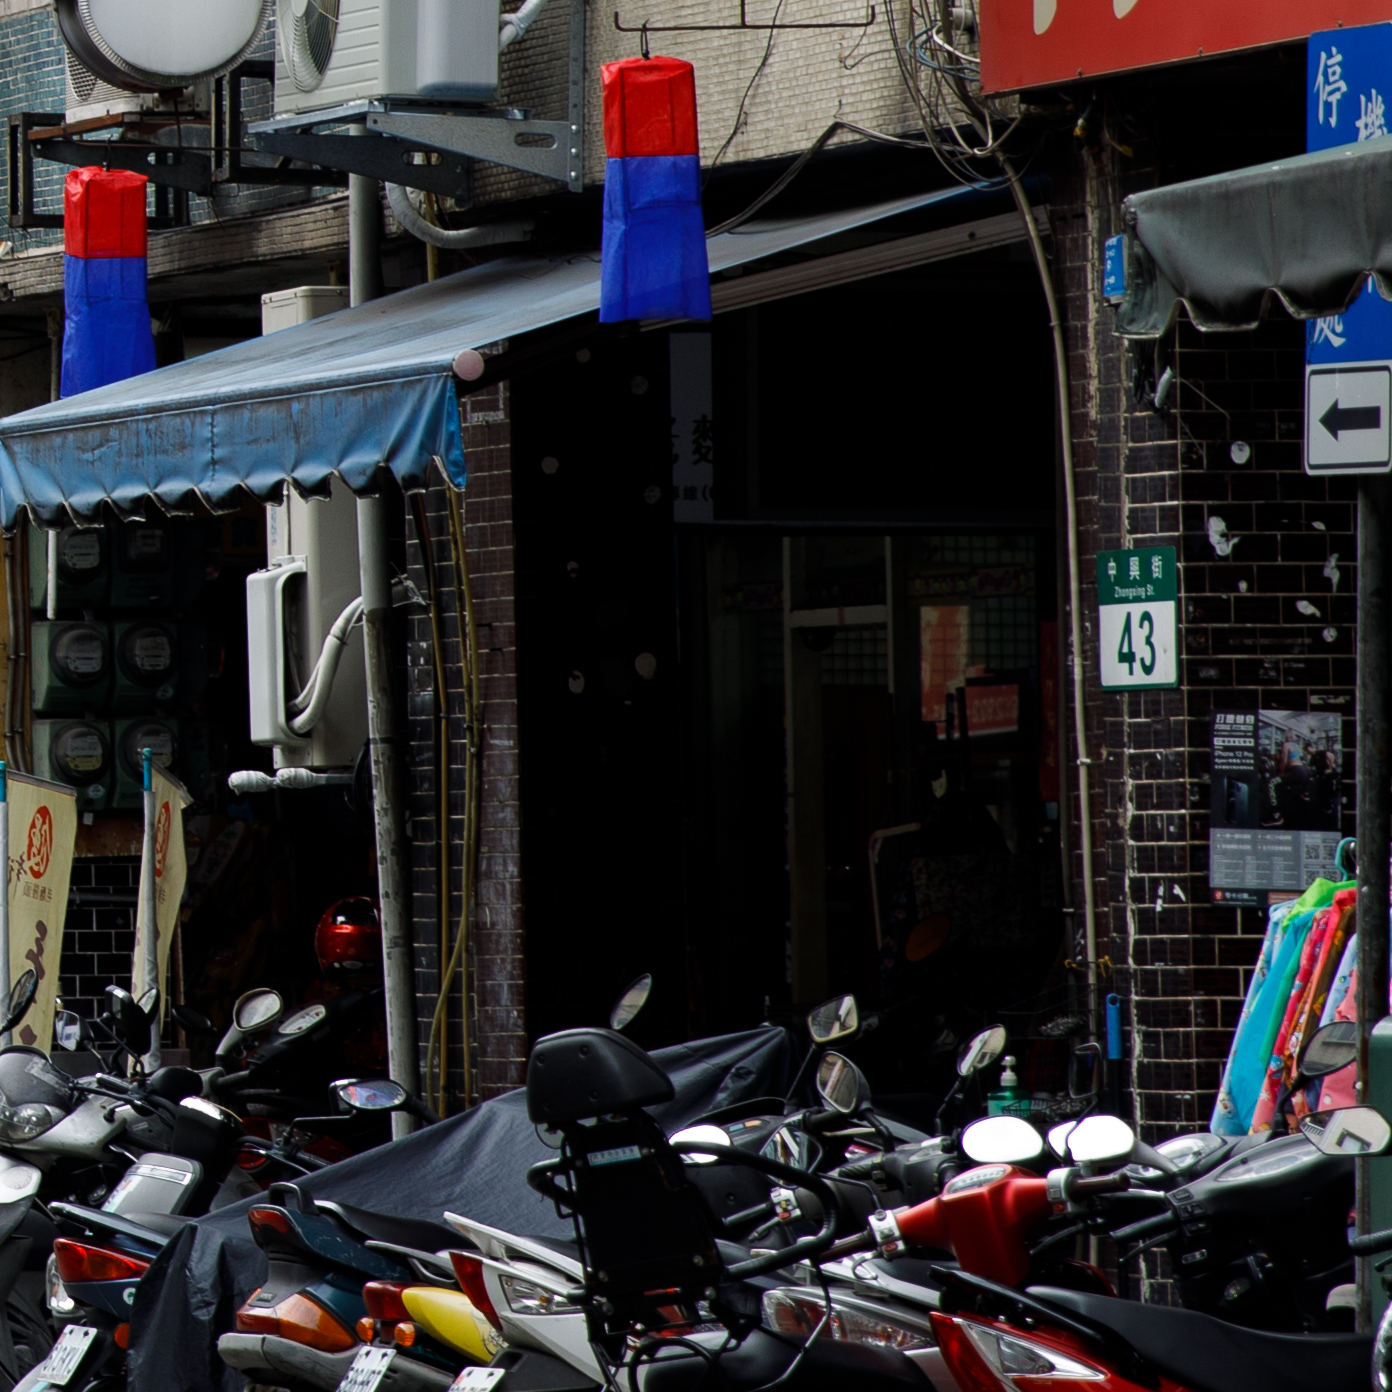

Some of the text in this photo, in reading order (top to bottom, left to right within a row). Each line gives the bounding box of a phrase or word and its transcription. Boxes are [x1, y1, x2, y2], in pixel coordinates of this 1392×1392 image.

[1108, 555, 1162, 583] 中興街
[1114, 583, 1155, 600] Zhongxing St.
[1118, 610, 1156, 676] 43
